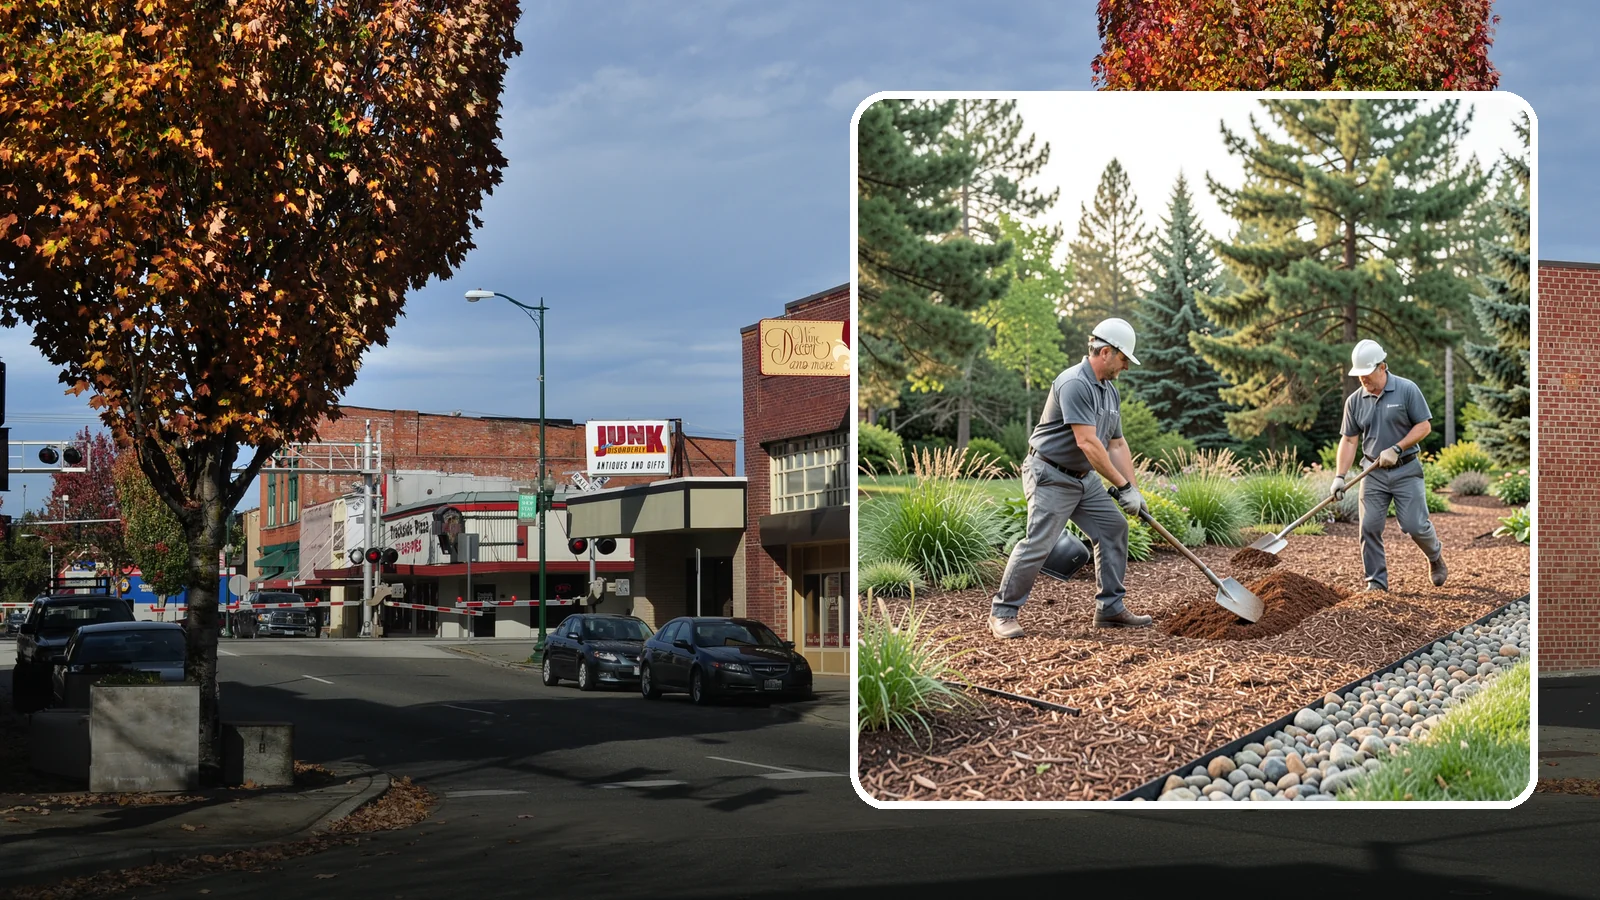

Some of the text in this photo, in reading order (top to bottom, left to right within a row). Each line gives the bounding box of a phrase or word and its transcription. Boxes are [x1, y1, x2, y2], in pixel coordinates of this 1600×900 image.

[595, 425, 665, 457] JUNK
[607, 446, 646, 454] DISORDERLY
[597, 460, 665, 470] ANTIQUES AND GIFTS
[573, 473, 589, 493] RAIL
[590, 476, 608, 492] SING
[352, 498, 364, 511] CRO
[414, 519, 429, 535] Pizza
